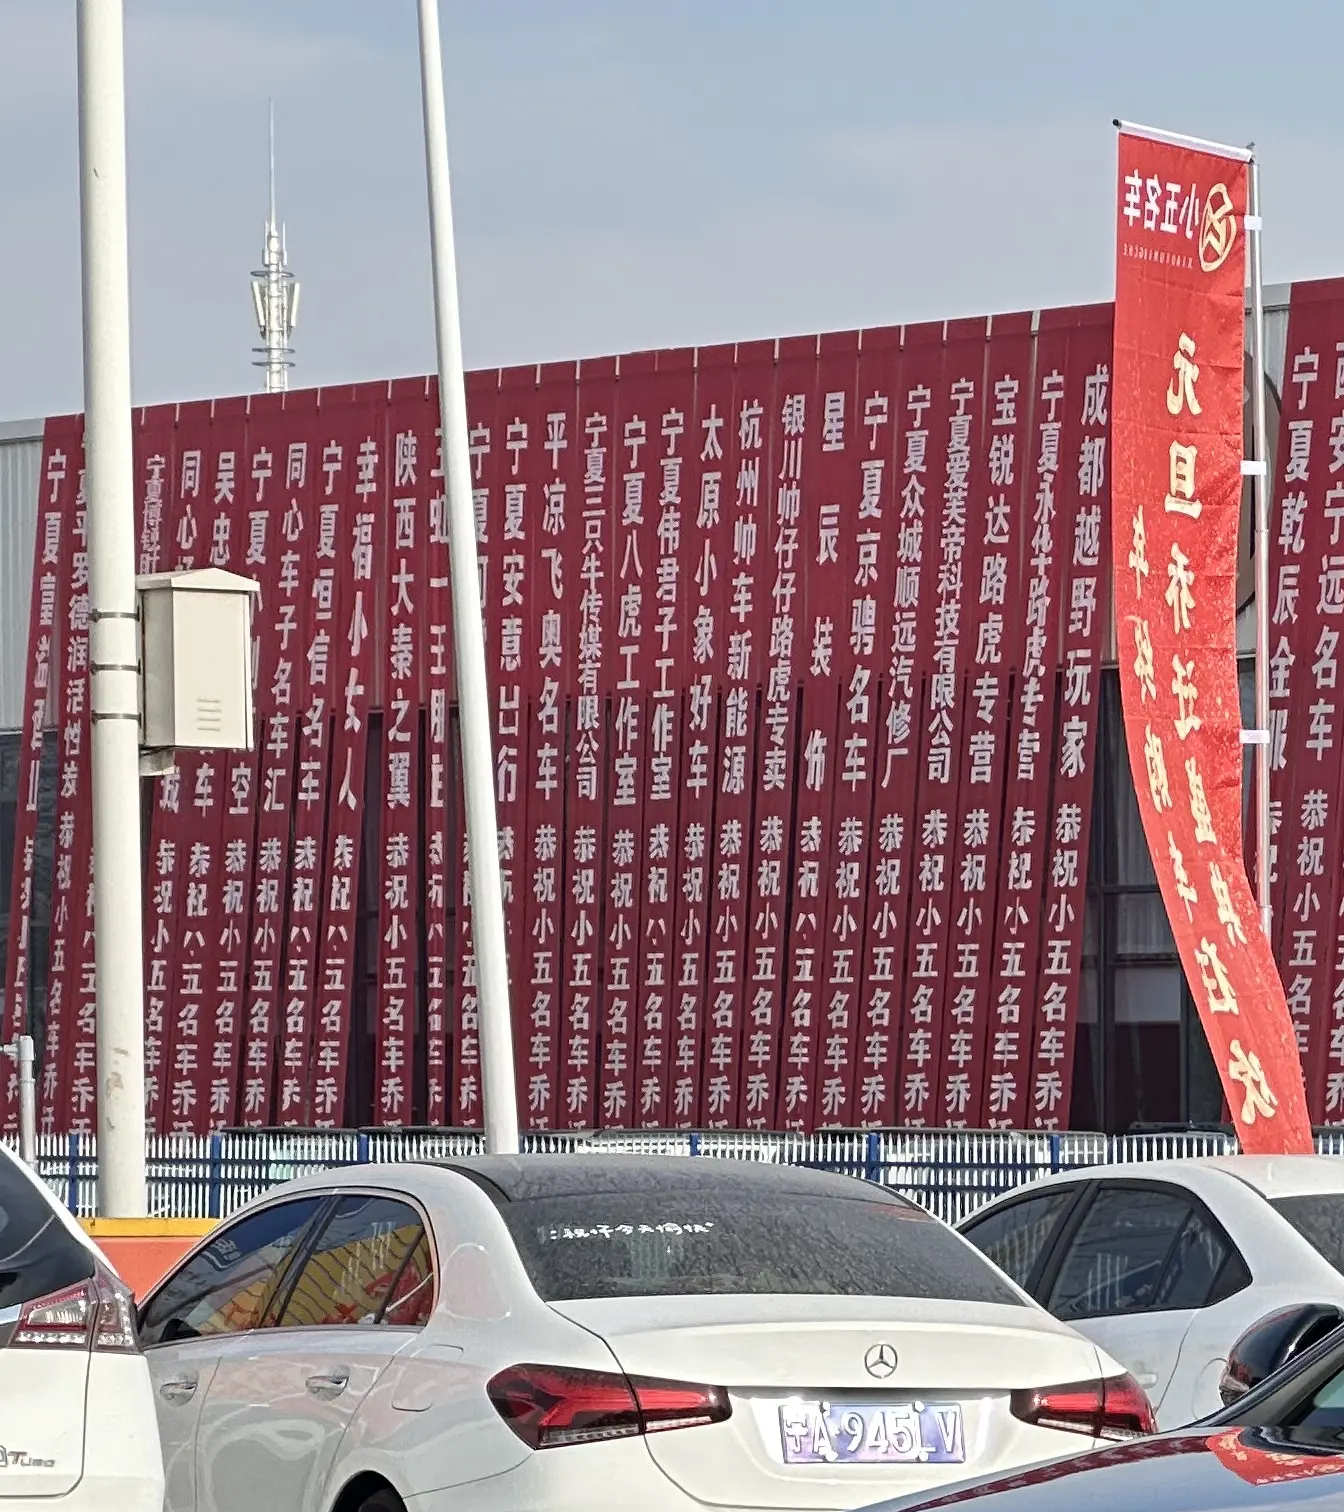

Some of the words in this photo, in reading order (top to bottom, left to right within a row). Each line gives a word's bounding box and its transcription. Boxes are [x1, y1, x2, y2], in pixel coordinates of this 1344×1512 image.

[264, 443, 306, 811] 同心车子名车汇
[298, 440, 342, 810] 宁夏恒信名车
[387, 430, 416, 808] 陕西大秦之翼
[536, 413, 567, 800] 平凉飞奥名车
[576, 412, 607, 800] 宁夏三只牛传媒有限公司
[614, 415, 645, 805] 宁夏八虎工作室
[650, 408, 683, 799] 宁夏伟君子工作室
[687, 404, 723, 798] 太原小象好车
[722, 399, 763, 794] 杭州帅车新能源
[763, 395, 805, 790] 银川帅仔仔路虎专卖
[928, 378, 973, 783] 宁夏爱芙帝科技有限公司
[969, 375, 1018, 783] 宝锐达路虎专营
[1061, 364, 1109, 778] 成都越野玩家
[42, 812, 74, 1134] 恭祝小五名车乔
[245, 838, 281, 1128] 恭祝小五名车乔
[282, 837, 316, 1127] 恭祝小五名车乔
[315, 835, 353, 1128] 恭祝小五名车乔
[381, 833, 408, 1125] 恭祝小五名车乔
[529, 824, 556, 1128] 恭祝小五名车乔
[567, 826, 596, 1127] 恭祝小五名车乔
[604, 830, 634, 1128] 恭祝小五名车乔
[641, 824, 669, 1127] 恭祝小五名车乔
[674, 823, 704, 1127] 恭祝小五名车乔
[709, 820, 742, 1128] 恭祝小五名车乔
[747, 816, 783, 1129] 恭祝小五名车乔
[786, 816, 821, 1131] 恭祝小五名车乔
[822, 817, 862, 1127] 恭祝小五名车乔
[861, 813, 903, 1127] 恭祝小五名车乔
[905, 809, 947, 1127] 恭祝小五名车乔
[944, 809, 989, 1129] 恭祝小五名车乔
[989, 807, 1035, 1128] 恭祝小五名车乔
[1035, 804, 1081, 1130] 恭祝小五名车乔
